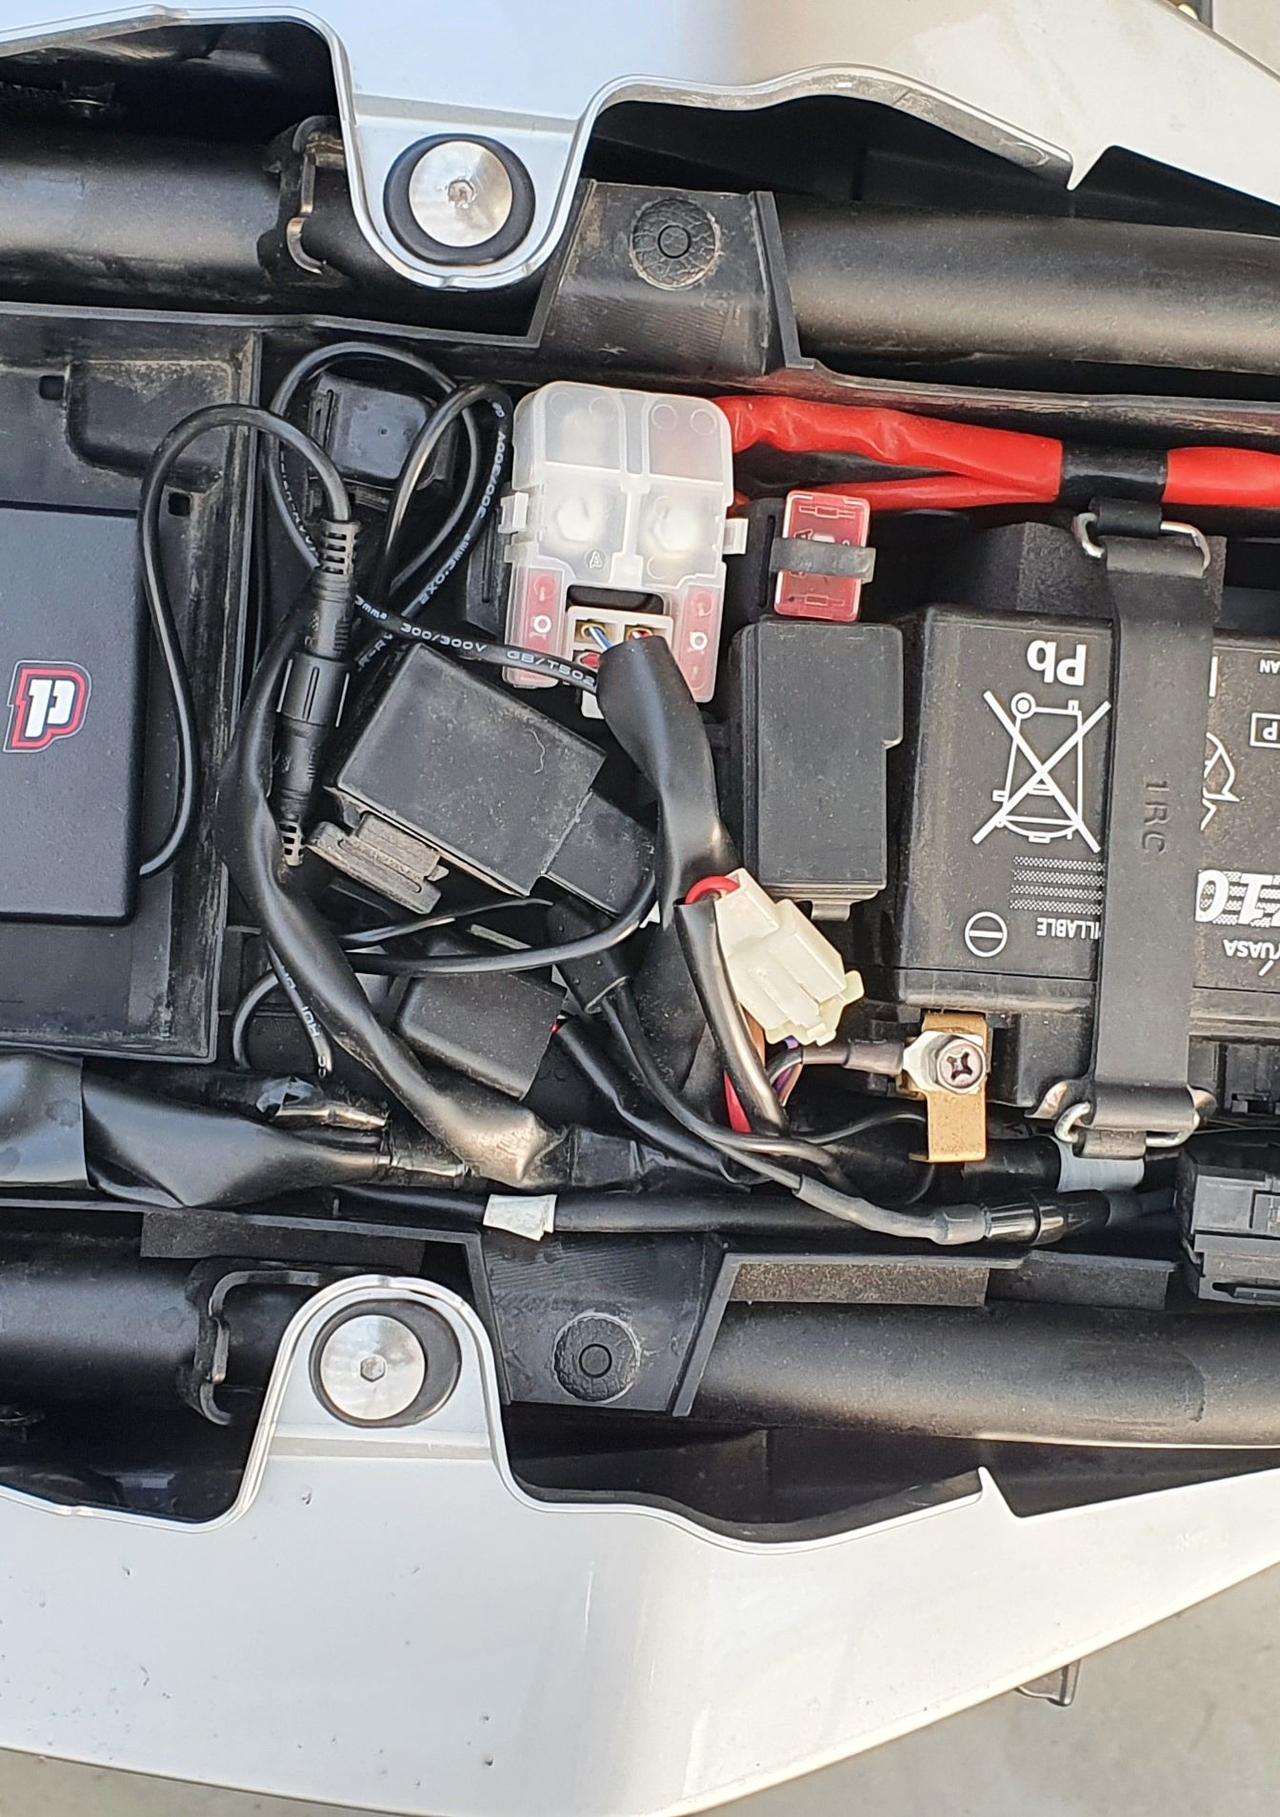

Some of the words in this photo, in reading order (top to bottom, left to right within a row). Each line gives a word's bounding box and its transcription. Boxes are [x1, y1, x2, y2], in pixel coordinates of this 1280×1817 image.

[400, 621, 488, 653] 300/300V
[1026, 640, 1088, 685] Pb
[1036, 918, 1101, 940] ILLABLE
